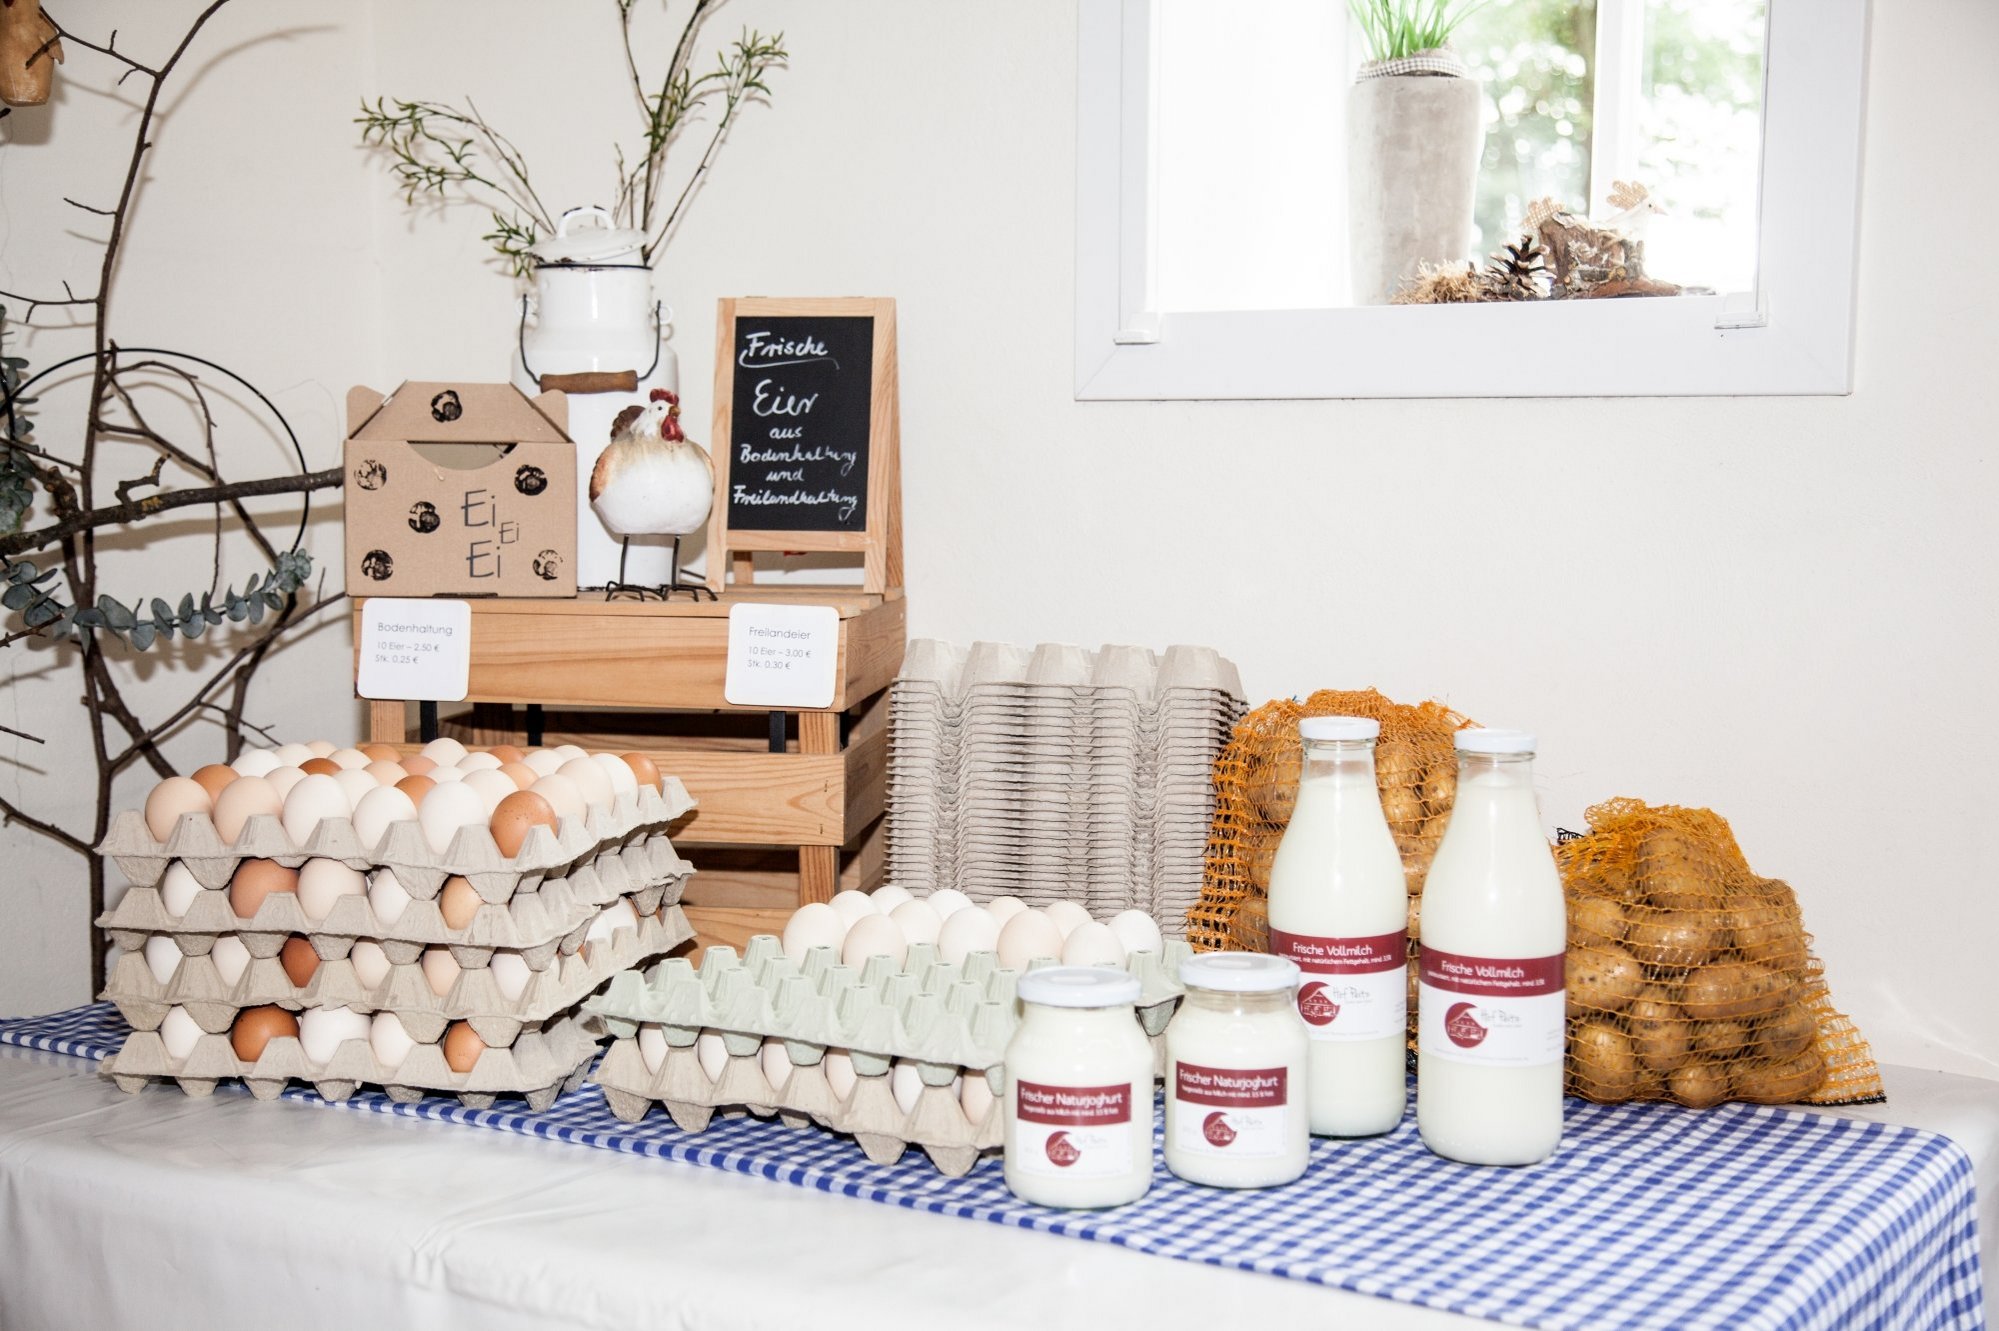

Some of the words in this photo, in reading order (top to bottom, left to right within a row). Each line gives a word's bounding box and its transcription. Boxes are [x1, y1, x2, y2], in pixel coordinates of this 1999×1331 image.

[745, 331, 829, 357] Frische
[752, 379, 819, 417] Eier
[769, 426, 803, 439] aus
[740, 443, 857, 477] Bodenhaltung
[765, 468, 804, 482] und
[461, 489, 496, 527] Ei
[733, 484, 858, 521] Freilandhaltung
[499, 521, 519, 544] Ei
[466, 540, 501, 578] Ei
[377, 622, 453, 637] Bodenhaltung
[748, 627, 811, 640] Freilandeier
[377, 641, 387, 650] 10
[388, 642, 405, 651] Eier
[433, 644, 440, 652] €
[749, 646, 759, 655] 10
[760, 647, 776, 656] Eier
[805, 650, 812, 658] €
[412, 656, 419, 664] €
[785, 661, 792, 670] €
[1293, 942, 1324, 956] Frische
[1326, 944, 1373, 957] Vollmilch
[1442, 960, 1473, 975] Frische
[1475, 965, 1525, 978] Vollmilch
[1180, 1069, 1211, 1085] Frischer
[1213, 1074, 1278, 1091] Naturjoghurt
[1021, 1087, 1054, 1104] Frischer
[1056, 1092, 1122, 1108] Naturjoghurt
